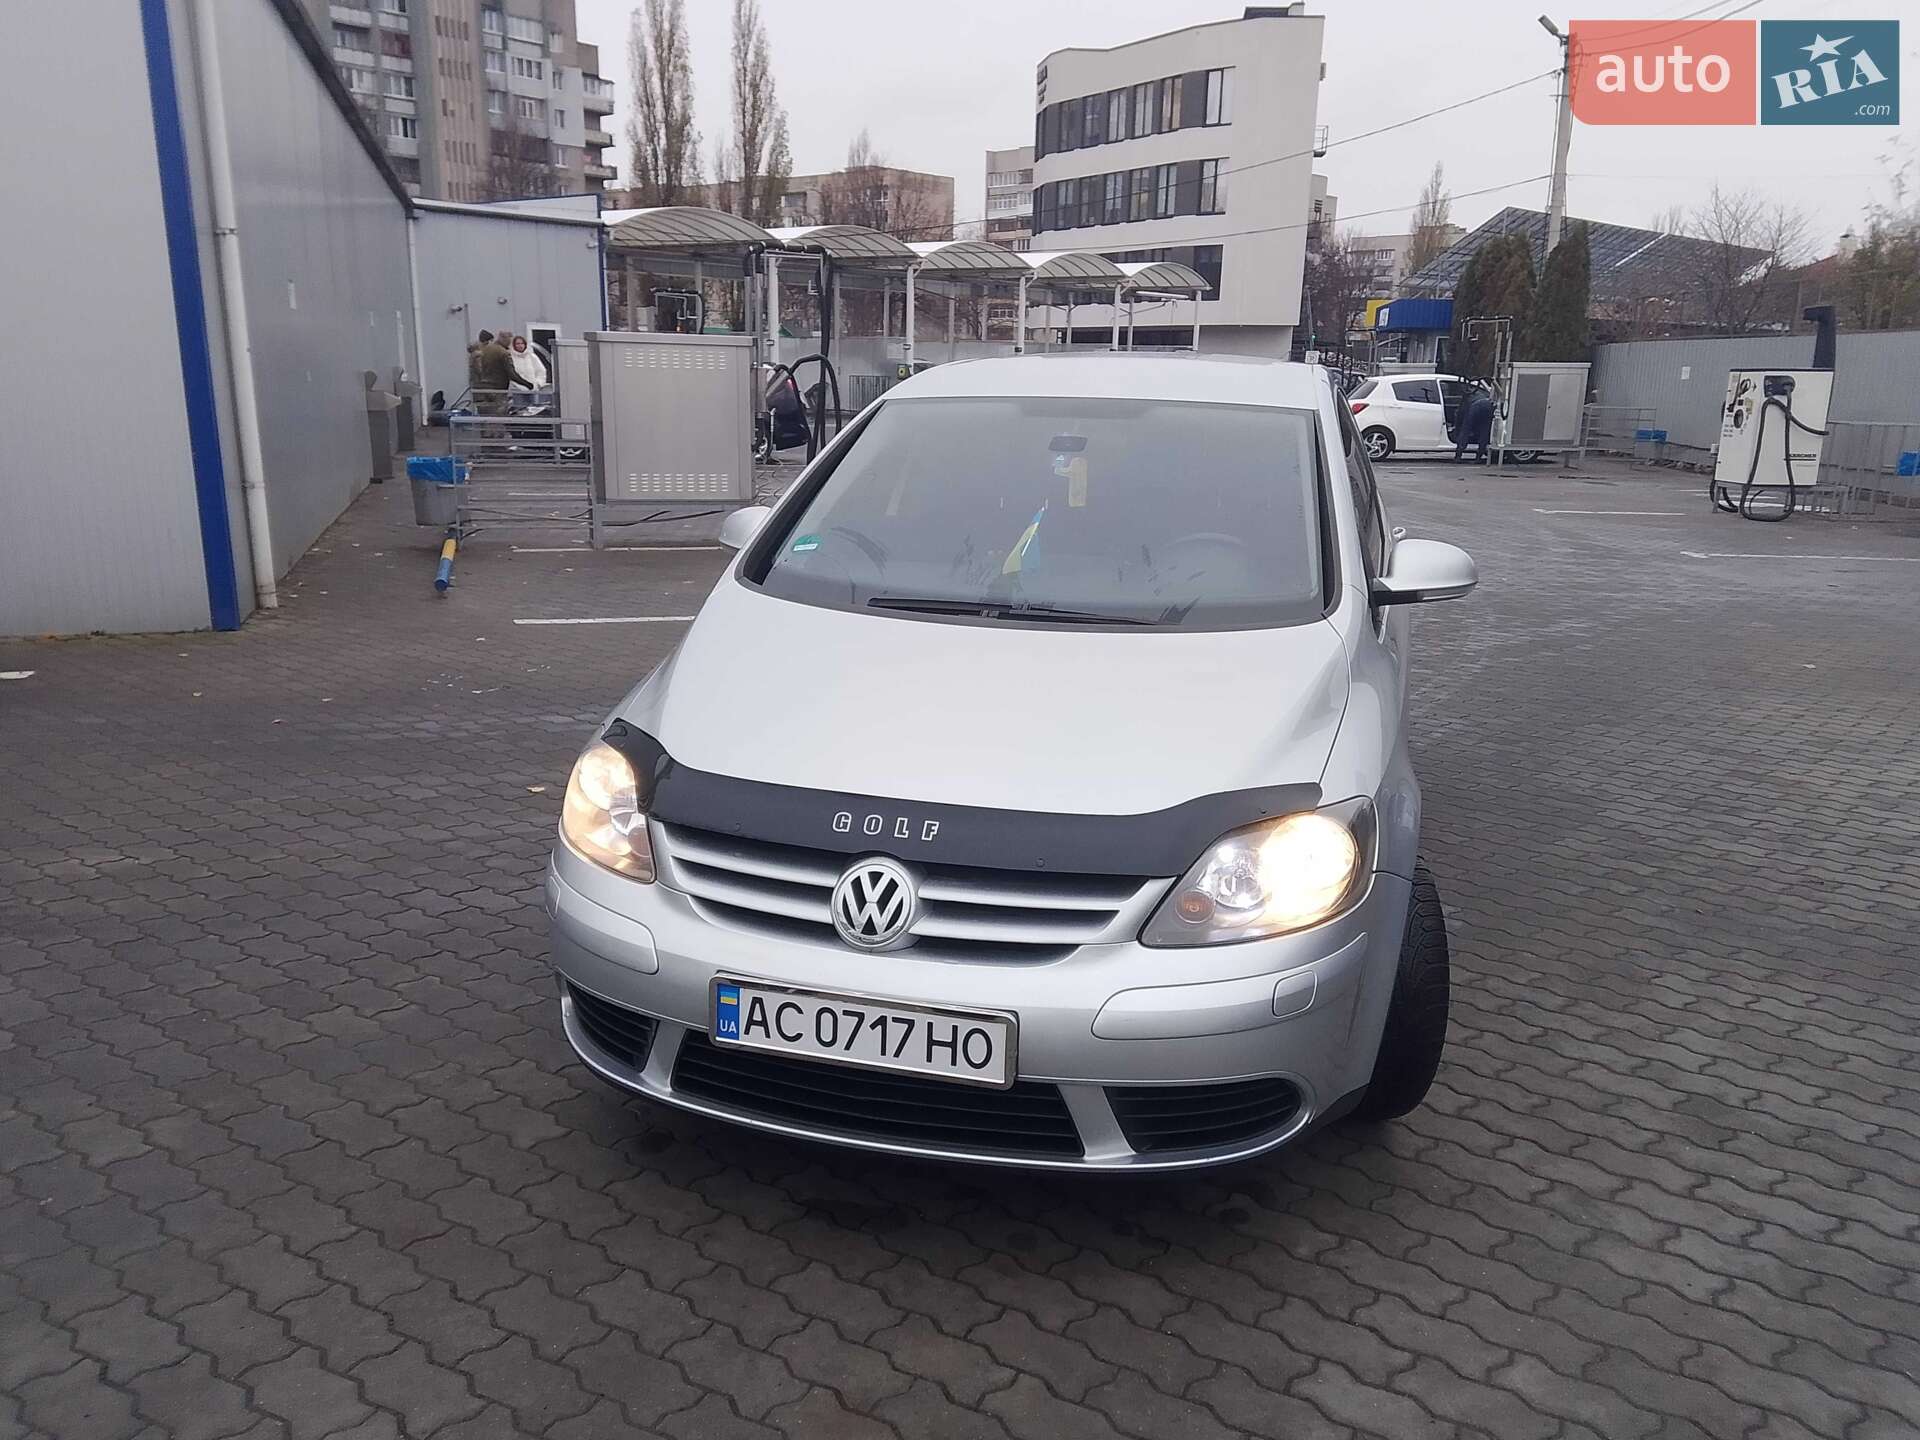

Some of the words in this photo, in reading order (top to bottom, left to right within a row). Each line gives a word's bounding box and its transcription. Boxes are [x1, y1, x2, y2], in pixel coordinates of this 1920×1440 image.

[832, 811, 940, 841] GOLF
[719, 1019, 737, 1034] UA
[743, 996, 804, 1043] AC
[815, 1007, 916, 1058] 0717
[926, 1021, 993, 1070] HO
